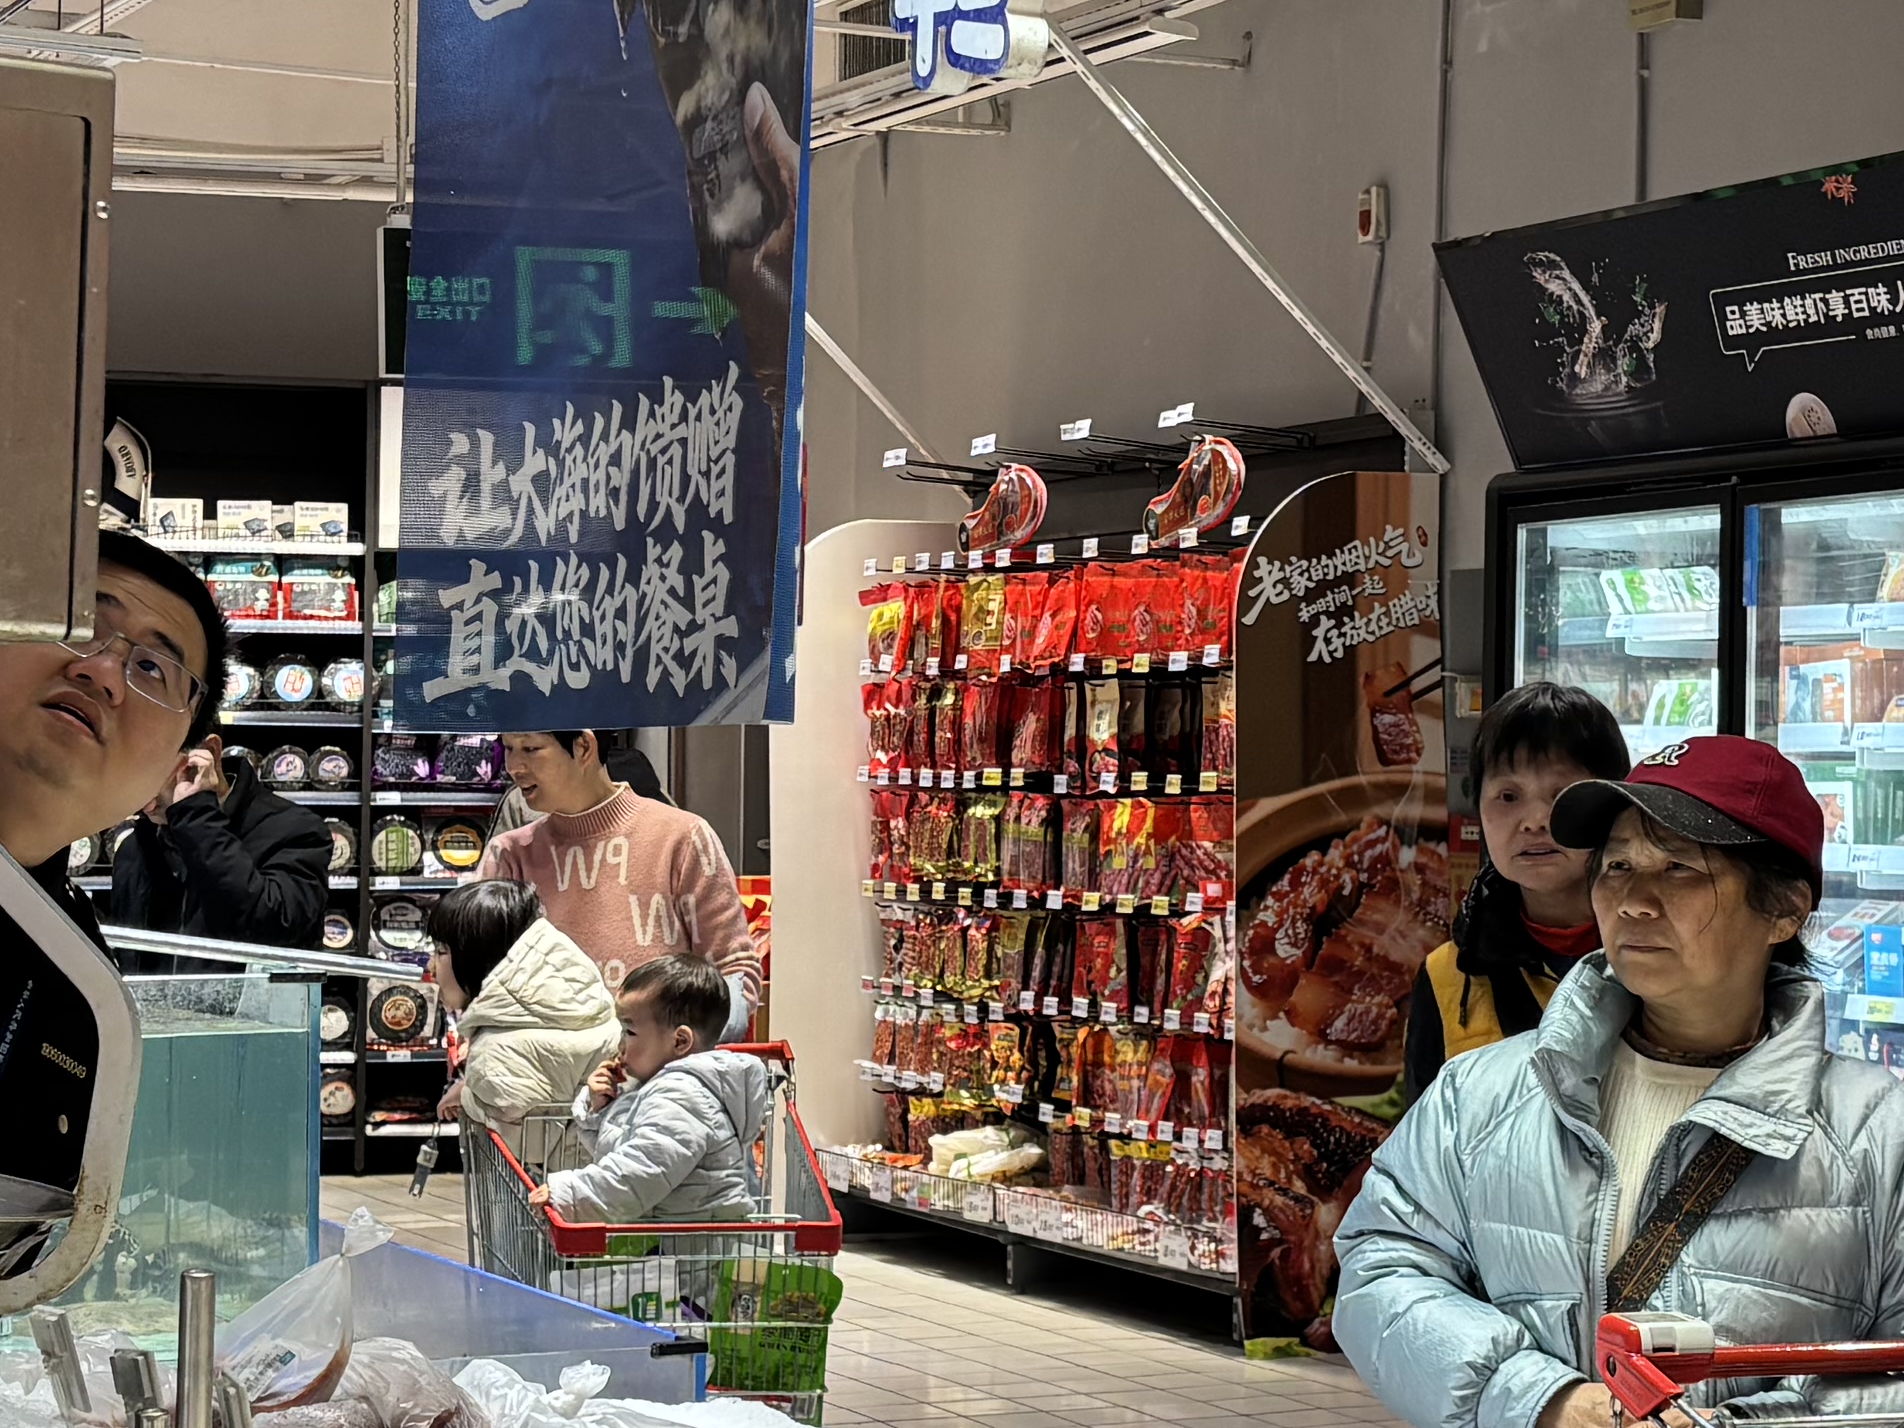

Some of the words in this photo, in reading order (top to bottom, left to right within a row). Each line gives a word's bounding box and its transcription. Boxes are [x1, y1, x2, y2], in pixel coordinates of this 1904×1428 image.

[1787, 251, 1833, 271] FRESH
[426, 360, 744, 548] 让大海的馈赠
[422, 530, 740, 704] 直达您的餐桌
[1241, 524, 1424, 626] 老家的烟火气
[1297, 573, 1387, 623] 和时间一起
[1306, 582, 1441, 664] 存放在腊味
